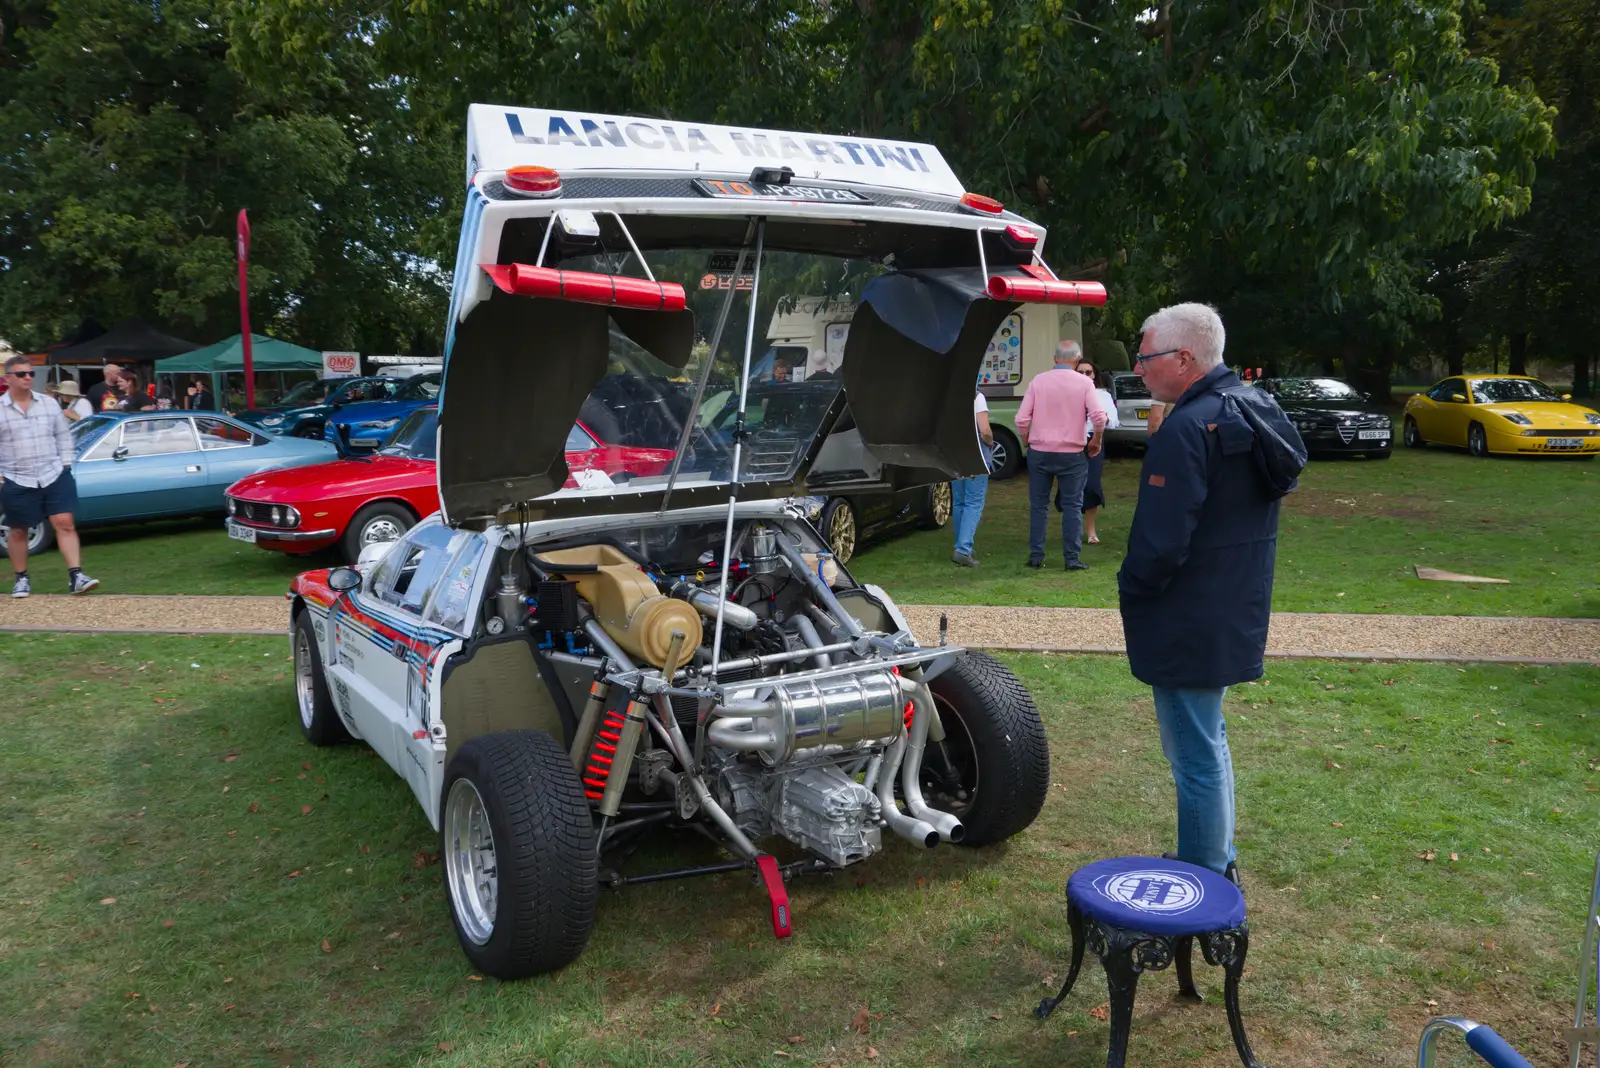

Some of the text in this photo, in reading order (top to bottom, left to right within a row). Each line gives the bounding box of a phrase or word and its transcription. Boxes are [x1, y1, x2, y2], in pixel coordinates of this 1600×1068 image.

[504, 112, 931, 173] LANCIA MARTINI
[707, 180, 753, 195] TO
[327, 355, 356, 369] OMG
